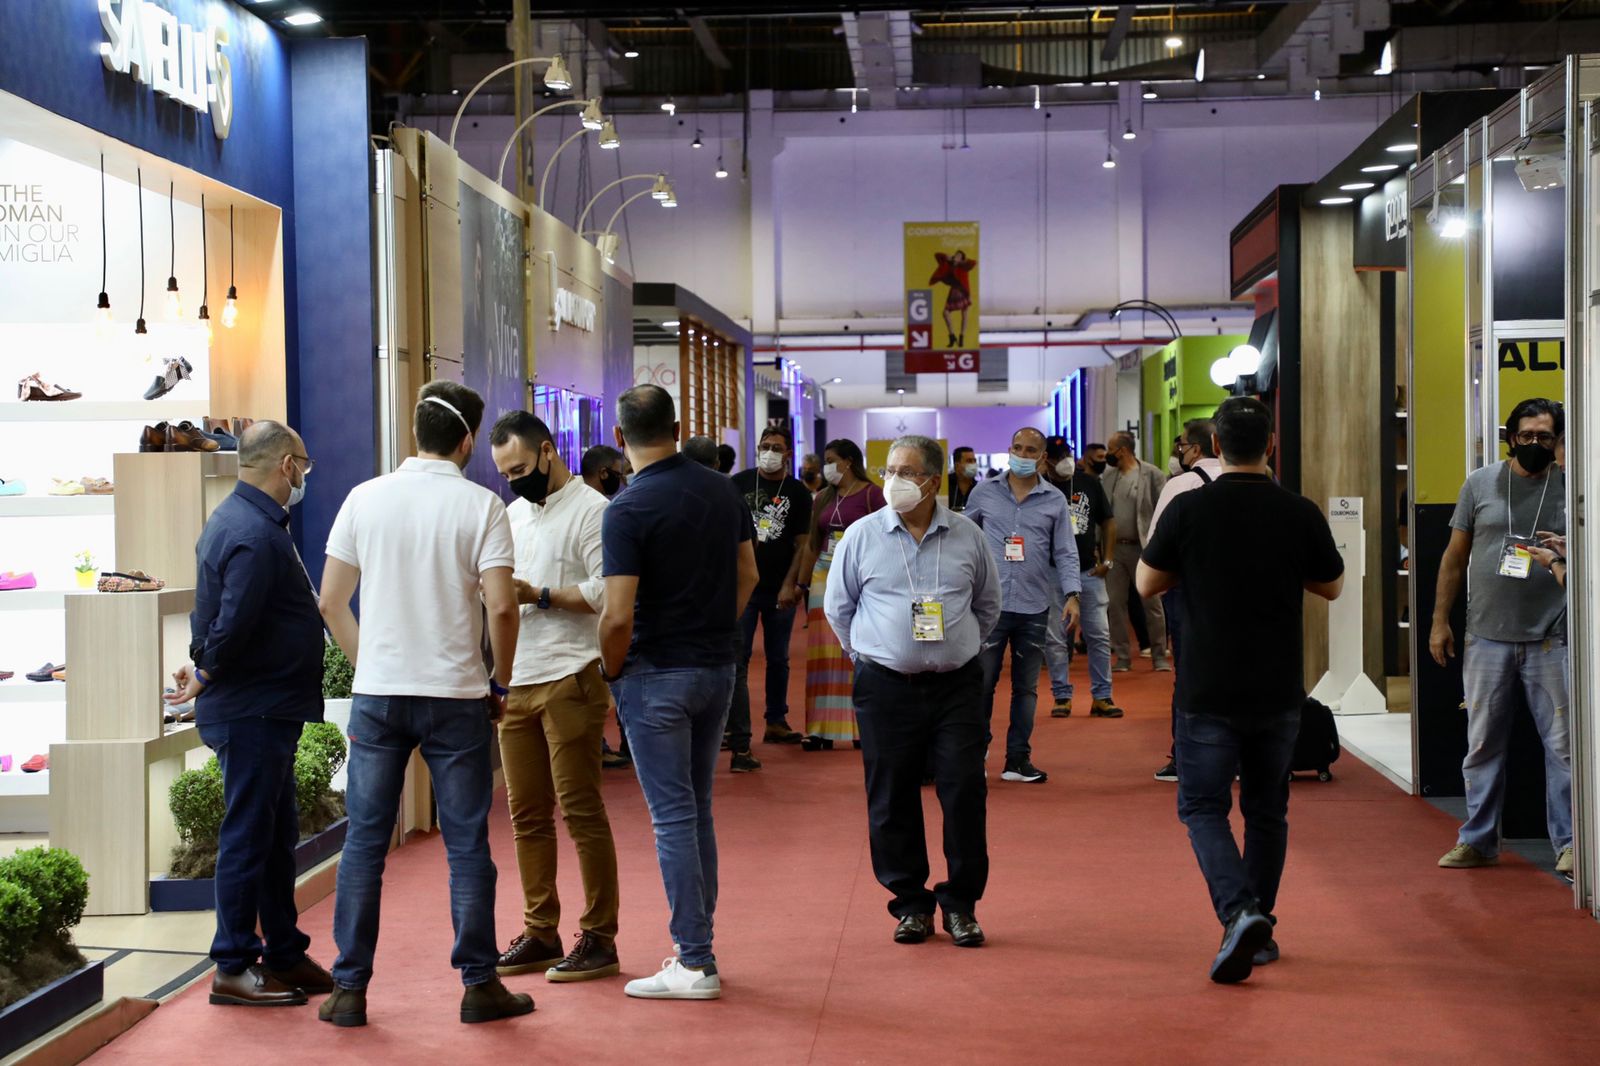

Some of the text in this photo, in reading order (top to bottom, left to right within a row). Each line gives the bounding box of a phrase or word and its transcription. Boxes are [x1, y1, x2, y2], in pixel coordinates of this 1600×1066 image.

[0, 184, 43, 202] THE
[28, 223, 79, 243] OUR
[910, 299, 928, 321] G
[958, 353, 974, 369] G
